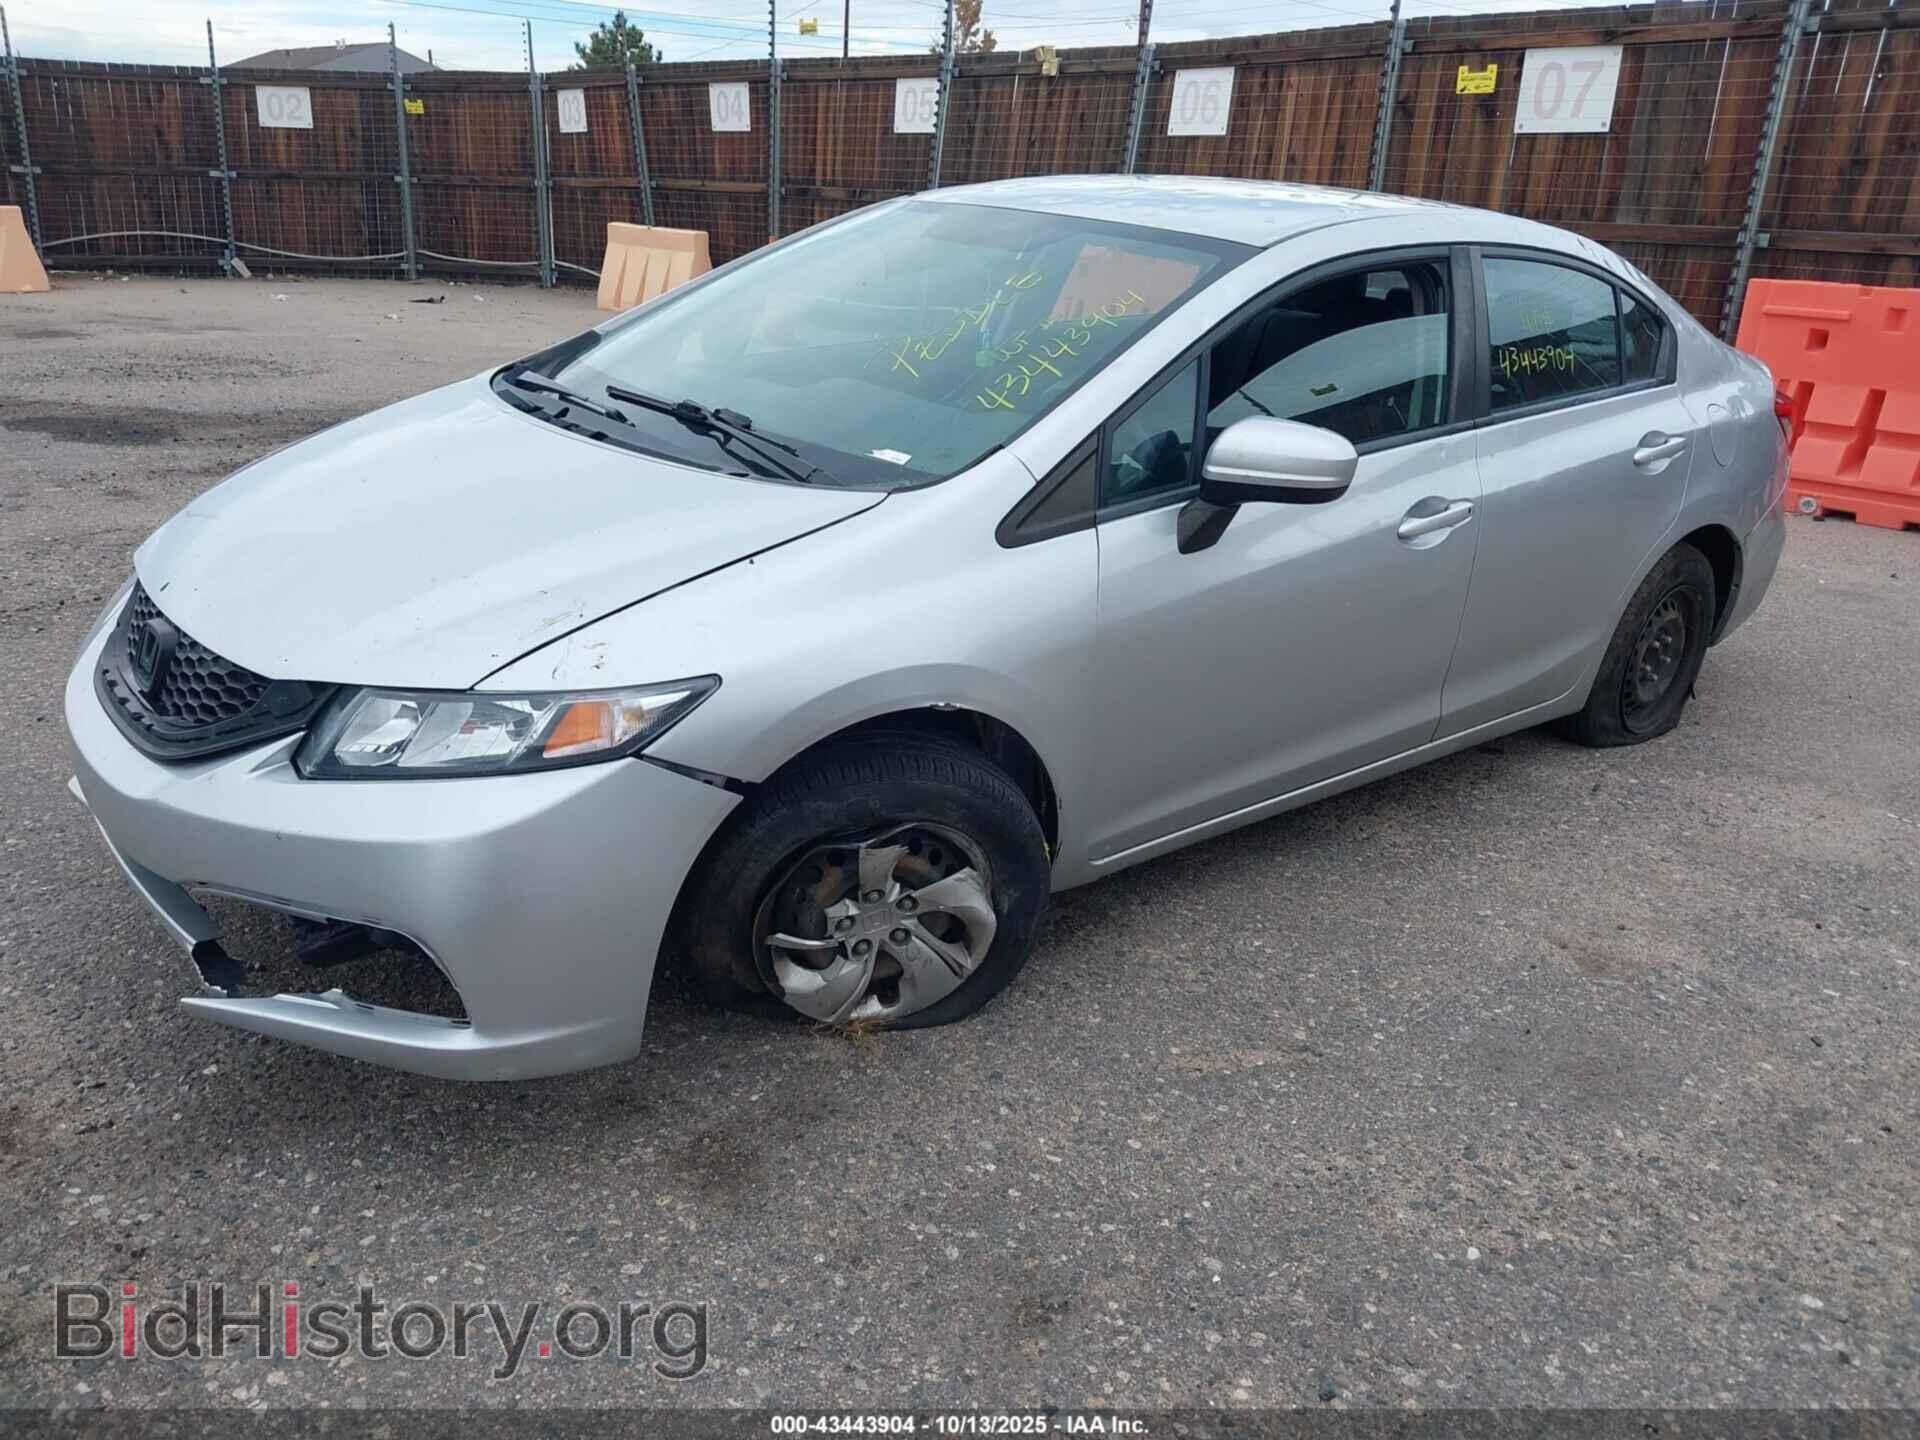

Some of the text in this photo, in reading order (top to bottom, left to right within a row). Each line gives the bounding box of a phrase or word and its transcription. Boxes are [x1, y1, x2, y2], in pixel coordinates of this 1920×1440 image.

[716, 89, 745, 122] 04
[902, 87, 933, 122] 05
[1180, 80, 1223, 124] 06
[1534, 60, 1605, 119] 07
[265, 94, 303, 121] 02
[562, 95, 582, 127] 03
[976, 289, 1146, 409] 43443904
[1499, 345, 1575, 378] 43443904
